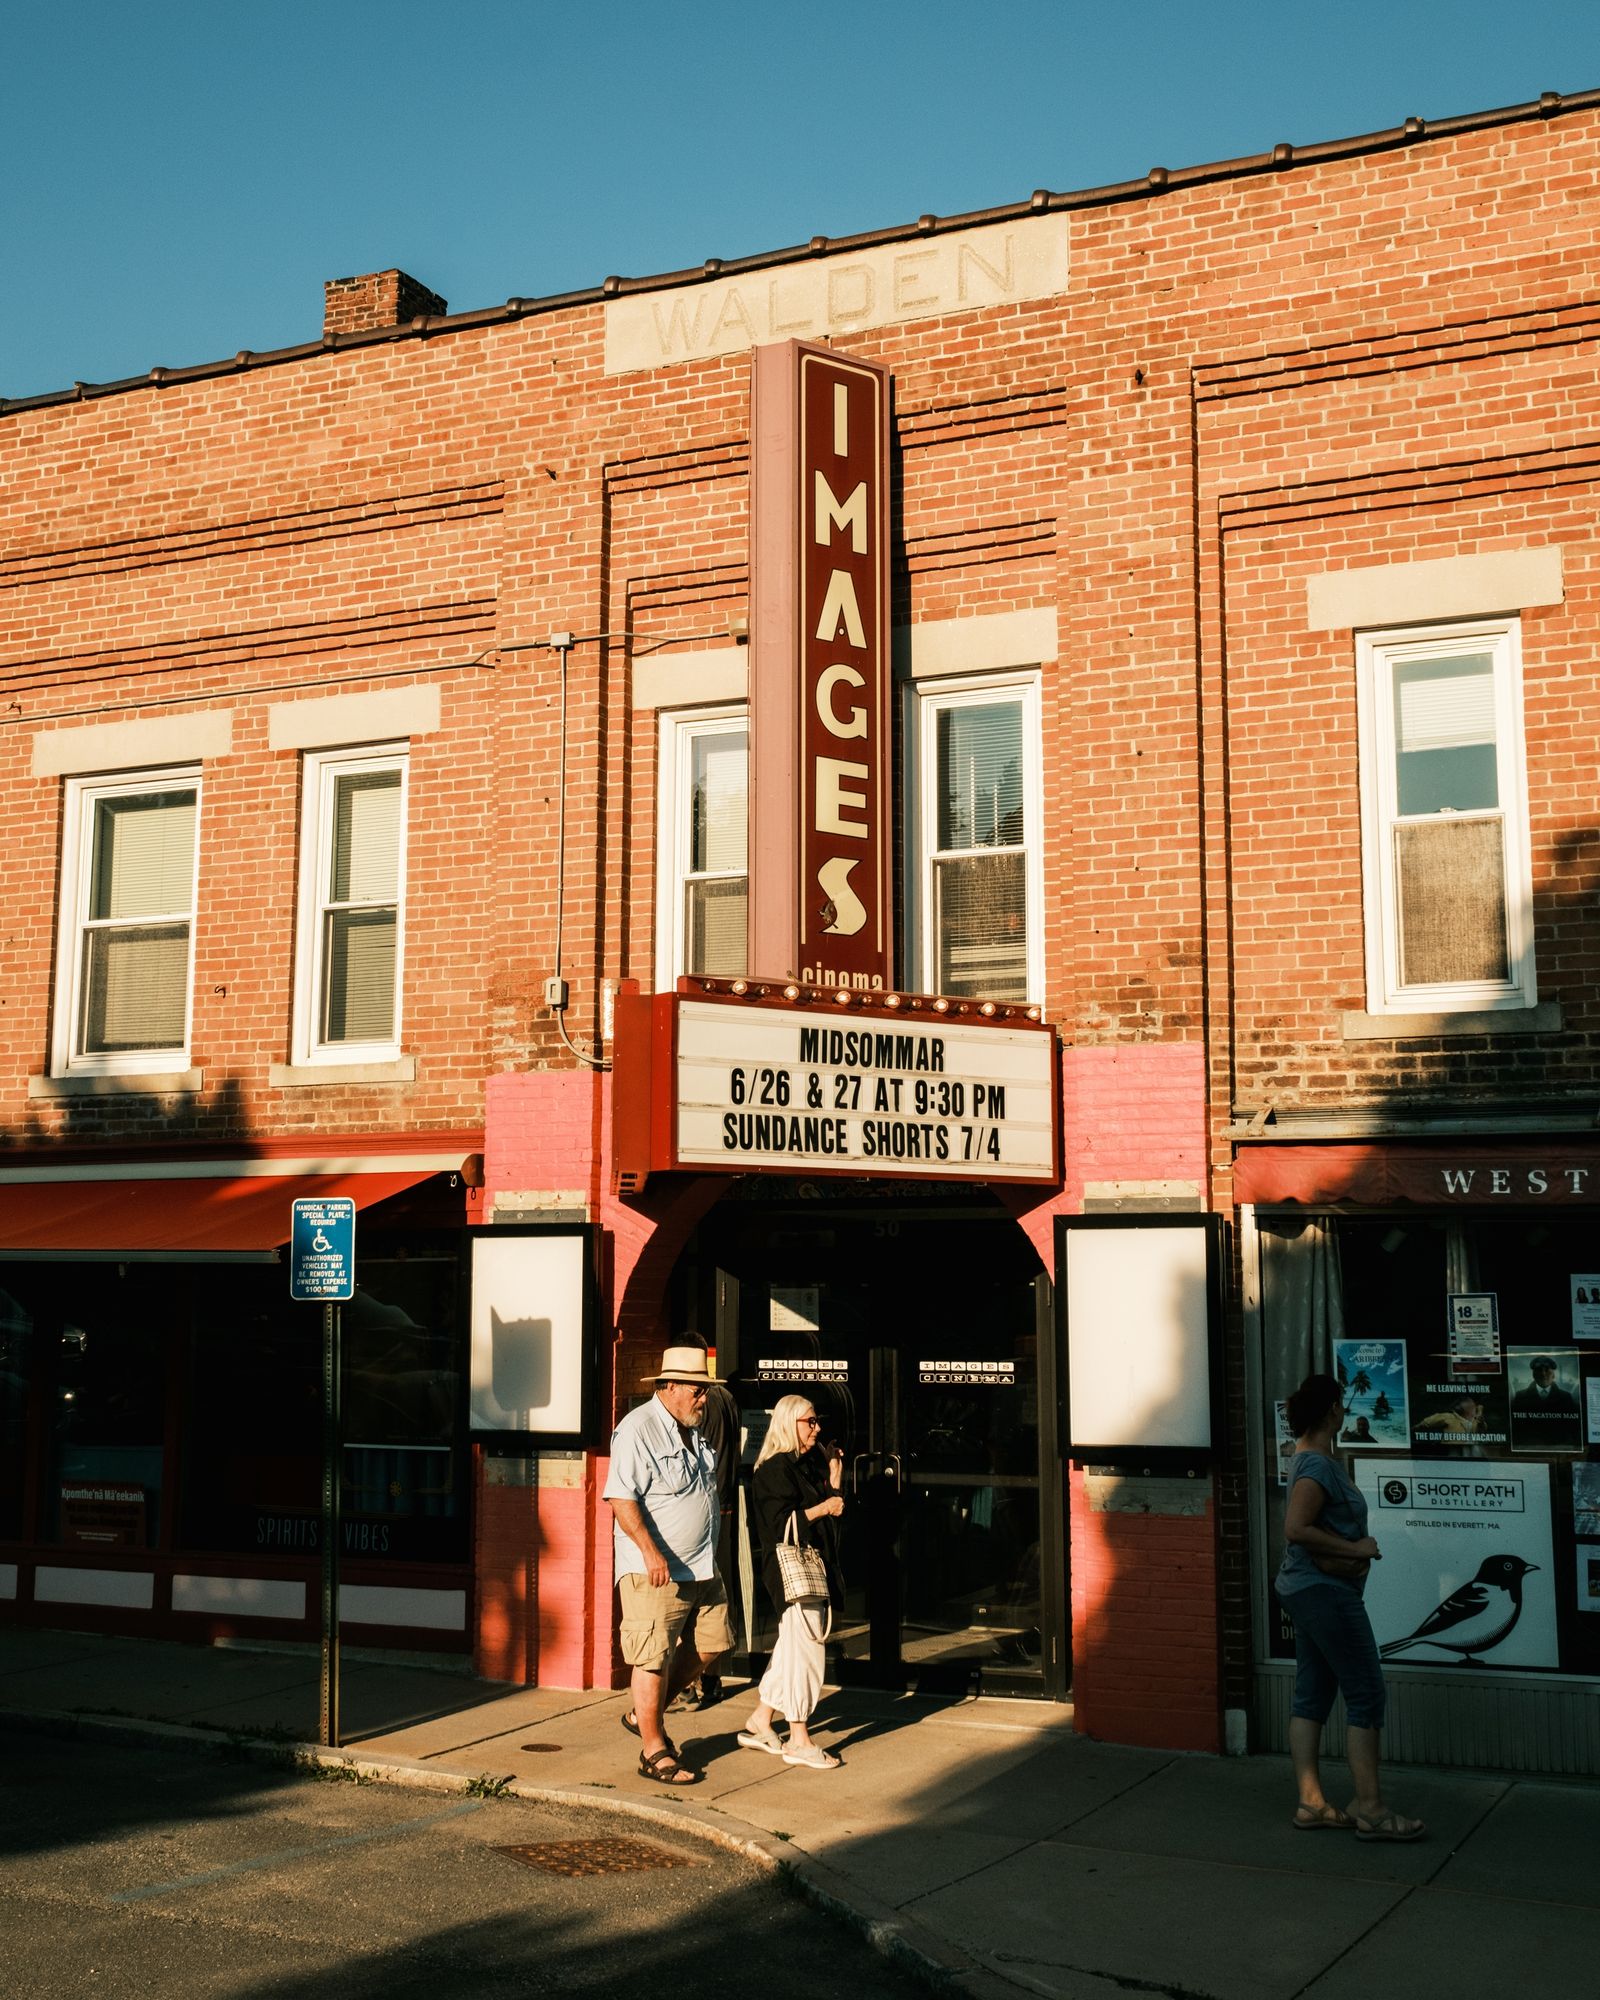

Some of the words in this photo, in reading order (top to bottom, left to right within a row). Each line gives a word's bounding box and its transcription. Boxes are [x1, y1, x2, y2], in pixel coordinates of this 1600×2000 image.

[651, 233, 1016, 356] WALDEN
[815, 382, 869, 937] IMAGES
[802, 961, 883, 991] cinema
[800, 1027, 944, 1073] MIDSOMMAR
[730, 1067, 791, 1107] 6/26
[806, 1072, 823, 1109] &
[834, 1074, 862, 1110] 27
[874, 1077, 904, 1113] AT
[914, 1079, 965, 1117] 9:30
[973, 1084, 1006, 1120] PM
[723, 1112, 848, 1154] SUNDANCE
[862, 1120, 949, 1161] SHORTS
[960, 1126, 1001, 1161] 7/4
[1440, 1169, 1589, 1194] WEST
[326, 1203, 351, 1211] PARKING
[302, 1211, 325, 1219] SPECIAL
[302, 1254, 344, 1262] UNAUTHORIZED
[298, 1270, 306, 1278] BE
[760, 1361, 848, 1370] IMAGES
[922, 1362, 1013, 1371] IMAGES
[760, 1372, 848, 1381] CINEMA
[922, 1374, 1013, 1383] CINEMA
[1426, 1384, 1438, 1392] ME
[1438, 1384, 1467, 1393] LEAVING
[1468, 1385, 1491, 1393] WORK
[1513, 1411, 1528, 1419] THE
[1528, 1412, 1562, 1420] VACATION
[1563, 1412, 1579, 1420] MAN
[1414, 1431, 1429, 1441] THE
[1429, 1432, 1443, 1441] DAY
[1444, 1432, 1470, 1442] BEFORE
[1471, 1433, 1507, 1442] VACATION
[1417, 1483, 1470, 1496] SHORT
[1475, 1485, 1515, 1498] PATH
[1431, 1498, 1504, 1507] DISTILLERY
[256, 1517, 318, 1547] SPIRITS
[344, 1521, 389, 1552] VIBES
